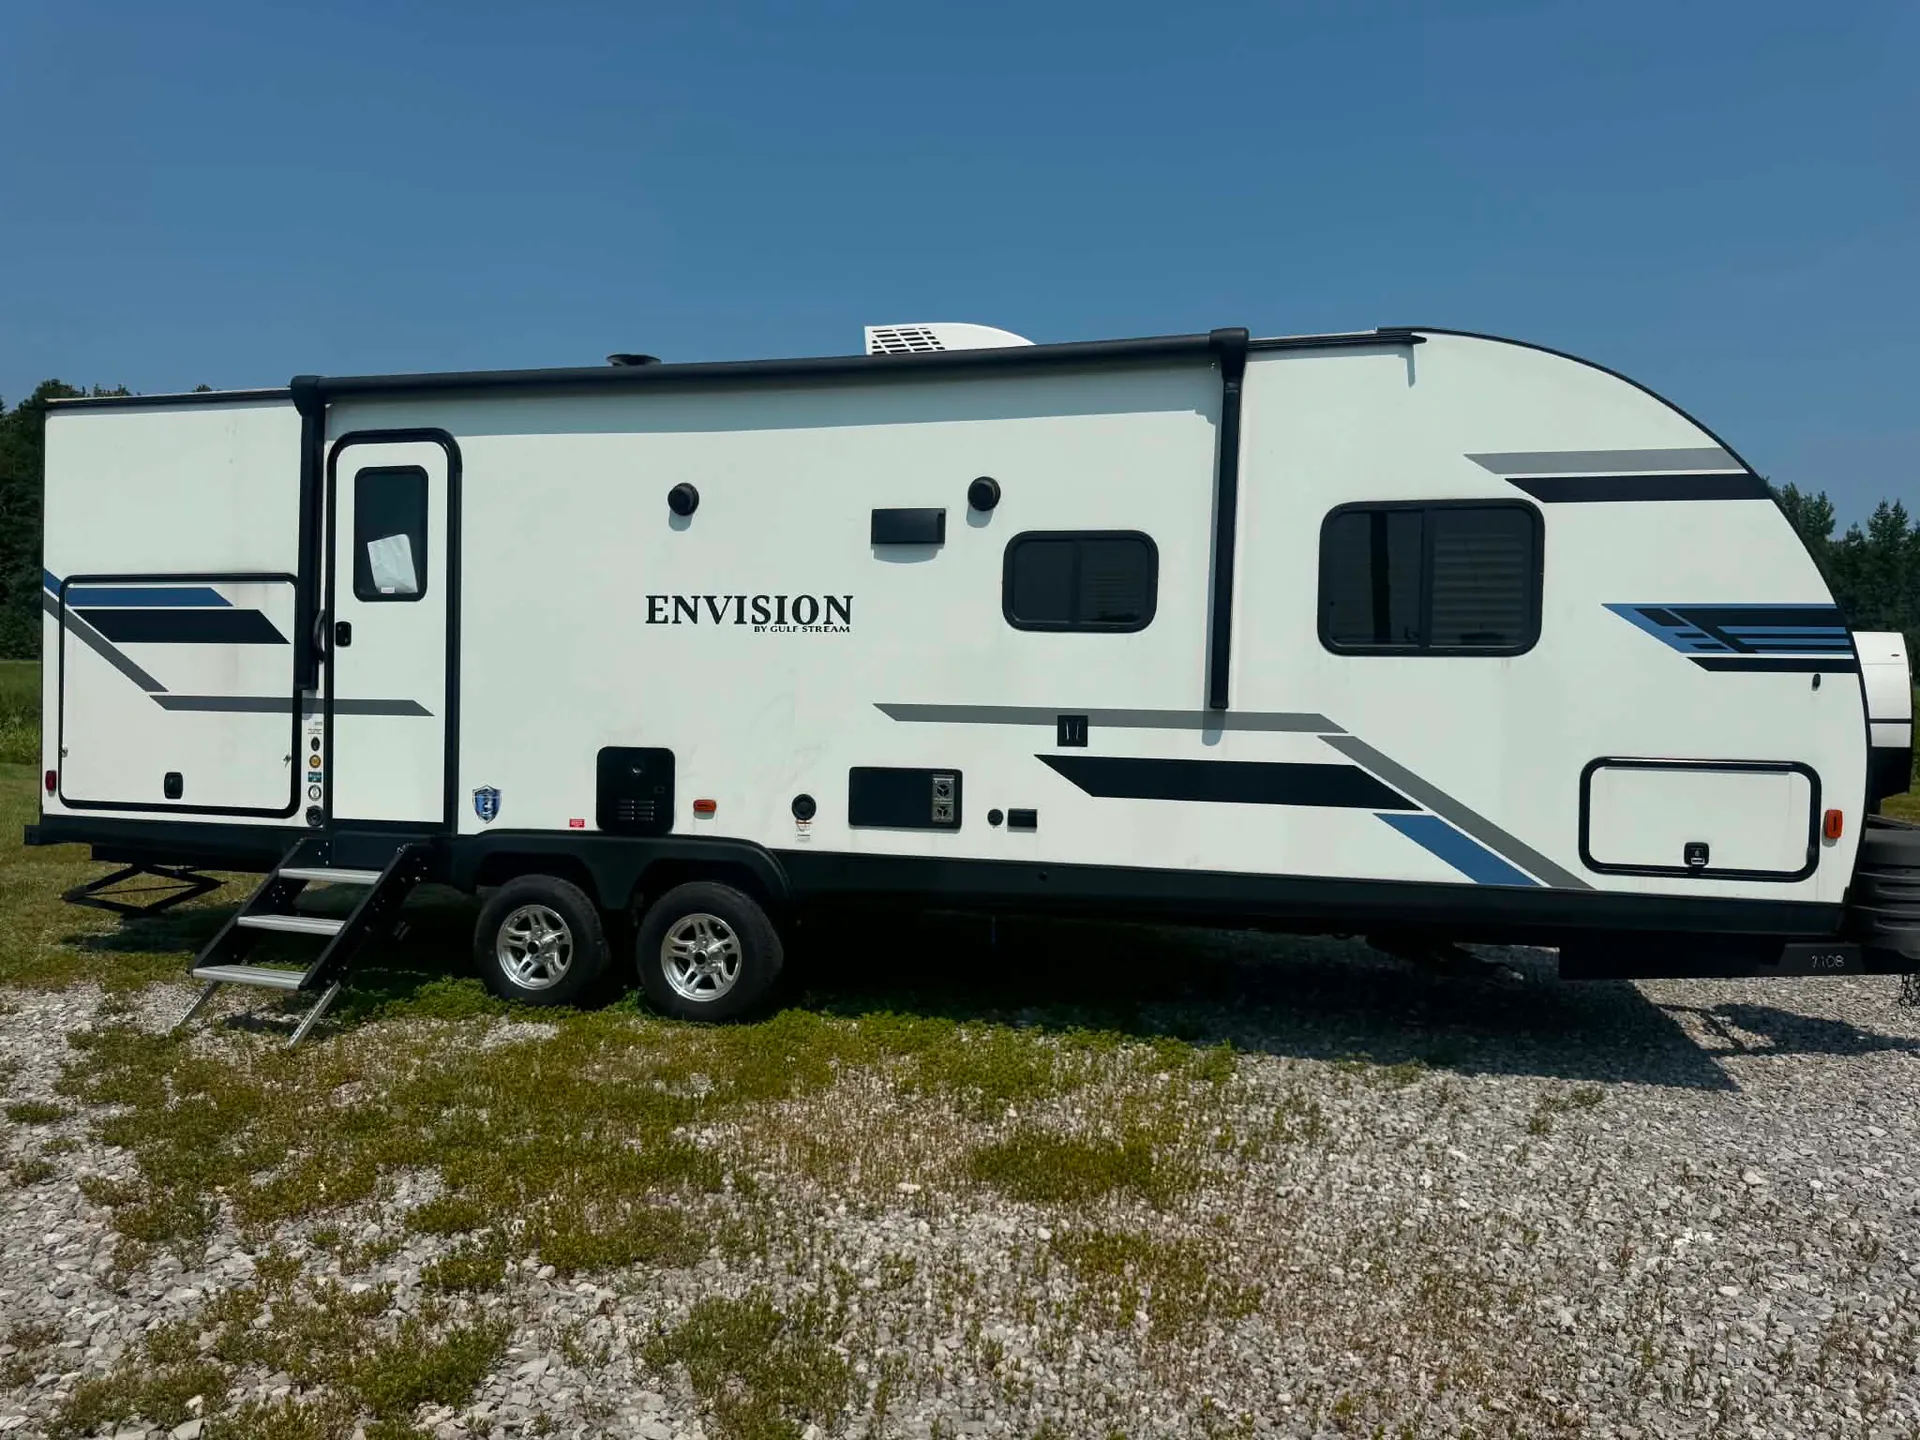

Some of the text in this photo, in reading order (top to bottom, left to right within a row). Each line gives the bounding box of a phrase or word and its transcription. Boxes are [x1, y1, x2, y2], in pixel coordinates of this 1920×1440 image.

[645, 594, 854, 625] ENVISION
[754, 625, 851, 633] BY GULF STREAM
